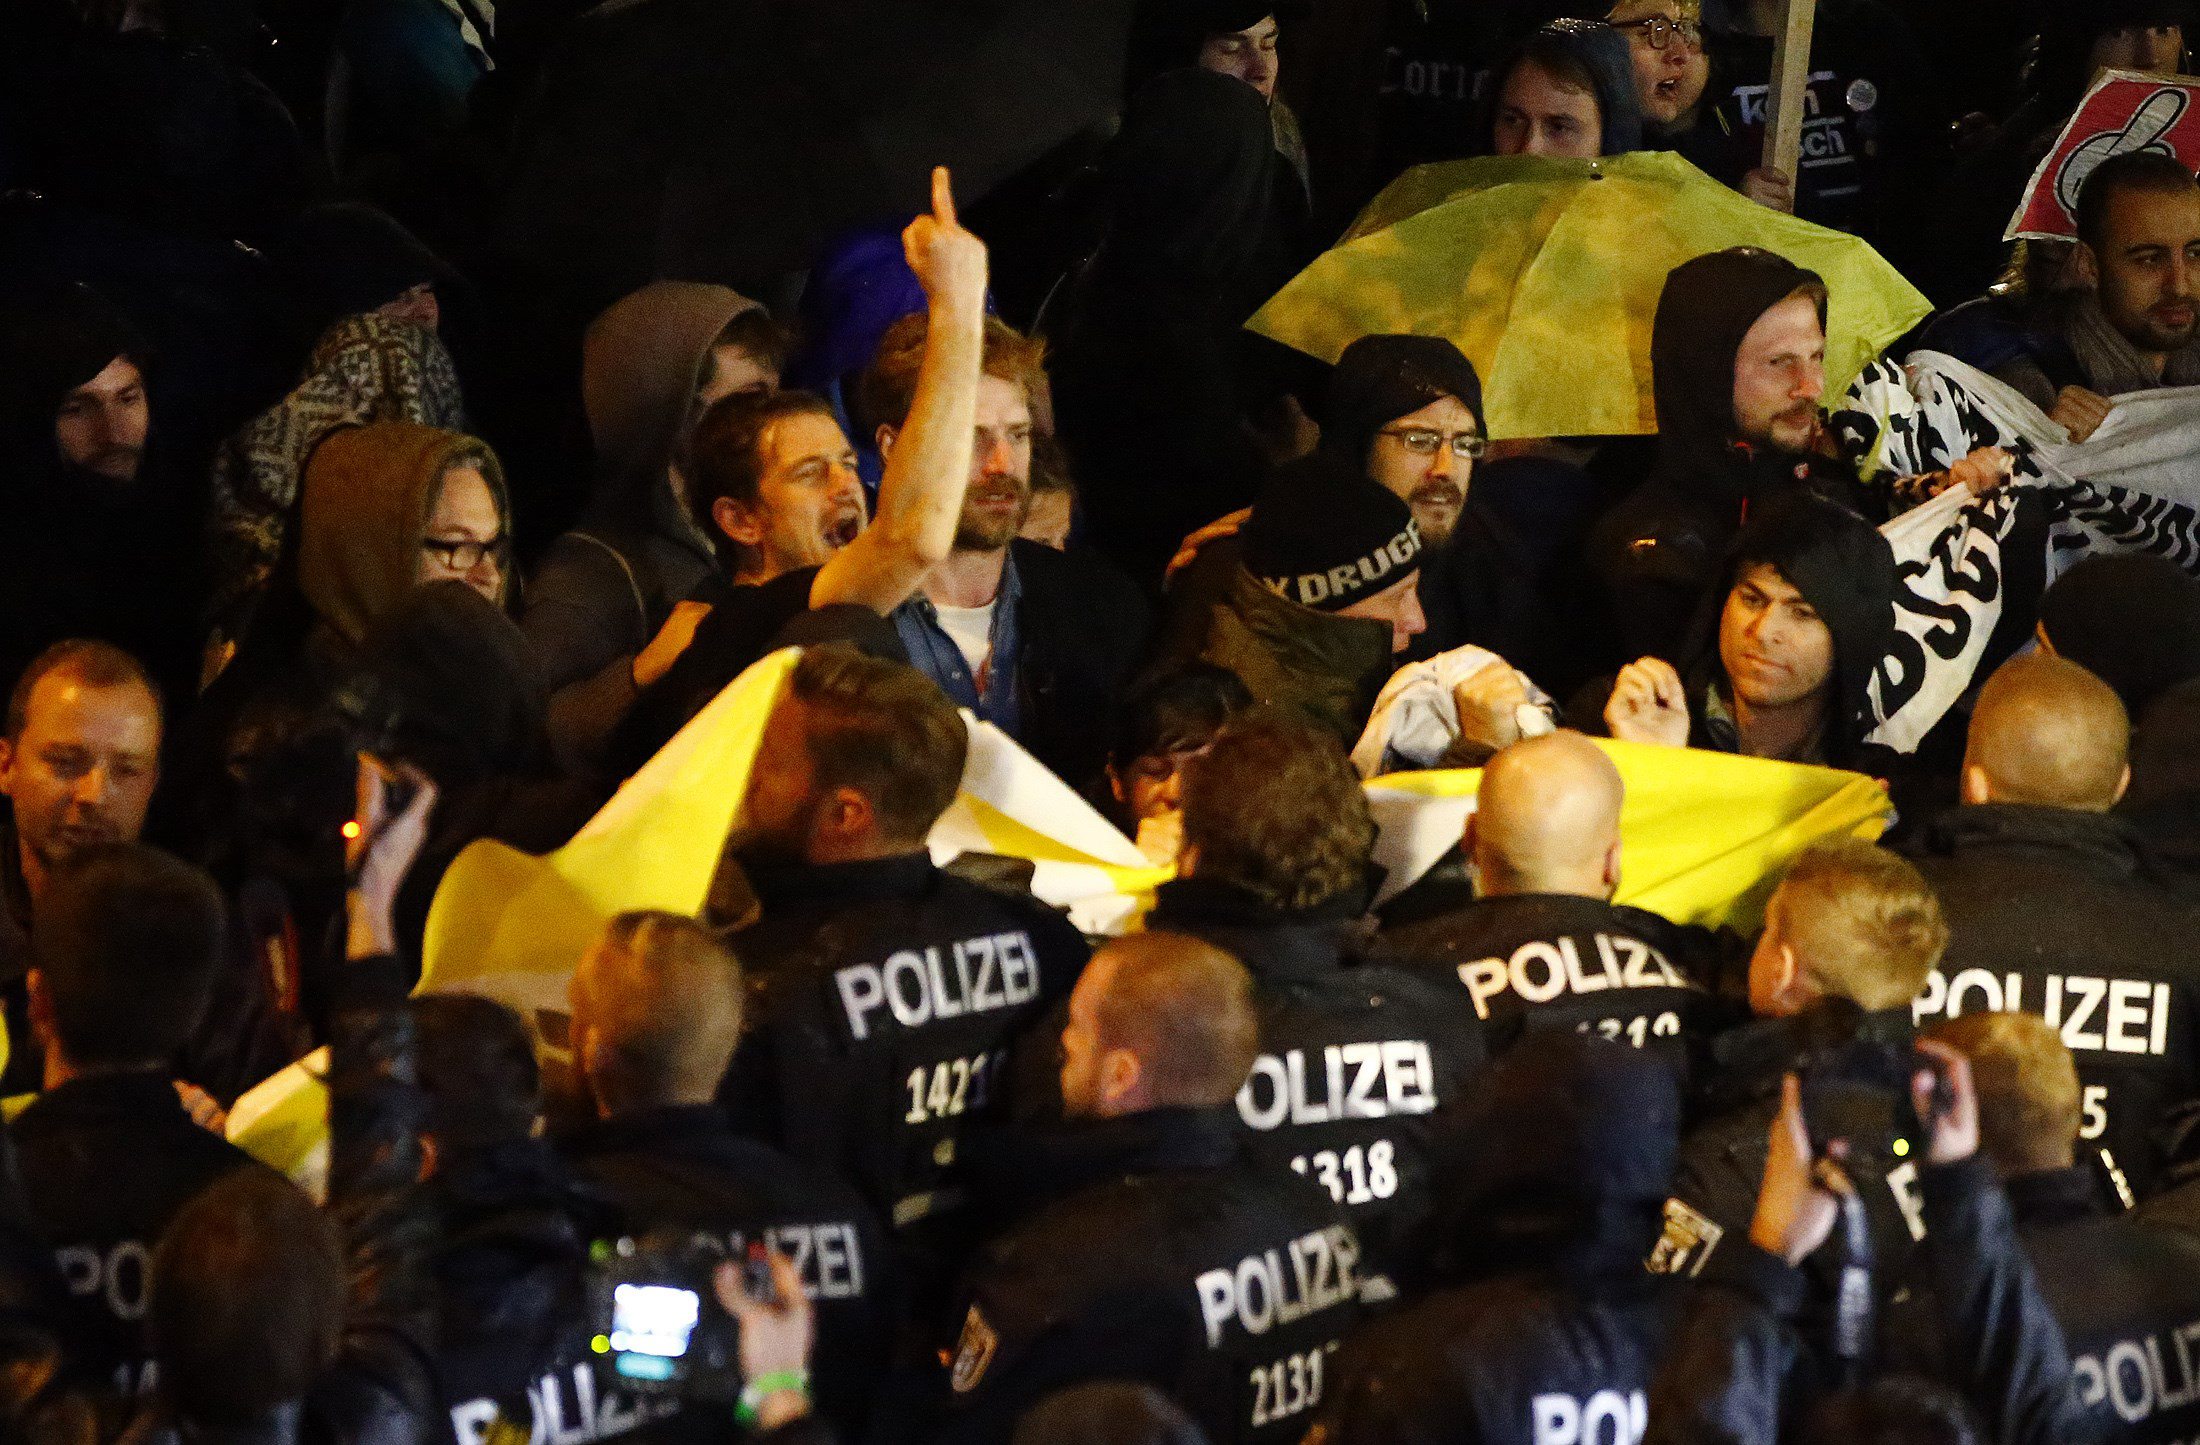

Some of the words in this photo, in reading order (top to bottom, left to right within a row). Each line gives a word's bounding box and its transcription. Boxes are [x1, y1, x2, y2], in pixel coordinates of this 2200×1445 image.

[833, 930, 1041, 1041] POLIZEI
[1456, 933, 1692, 1021] POLIZ
[1235, 1040, 1440, 1131] OLIZEI
[1290, 1139, 1399, 1205] 318
[1195, 1225, 1398, 1351] POLIZ
[1250, 1340, 1340, 1428] 2131
[2072, 1324, 2200, 1422] POLI
